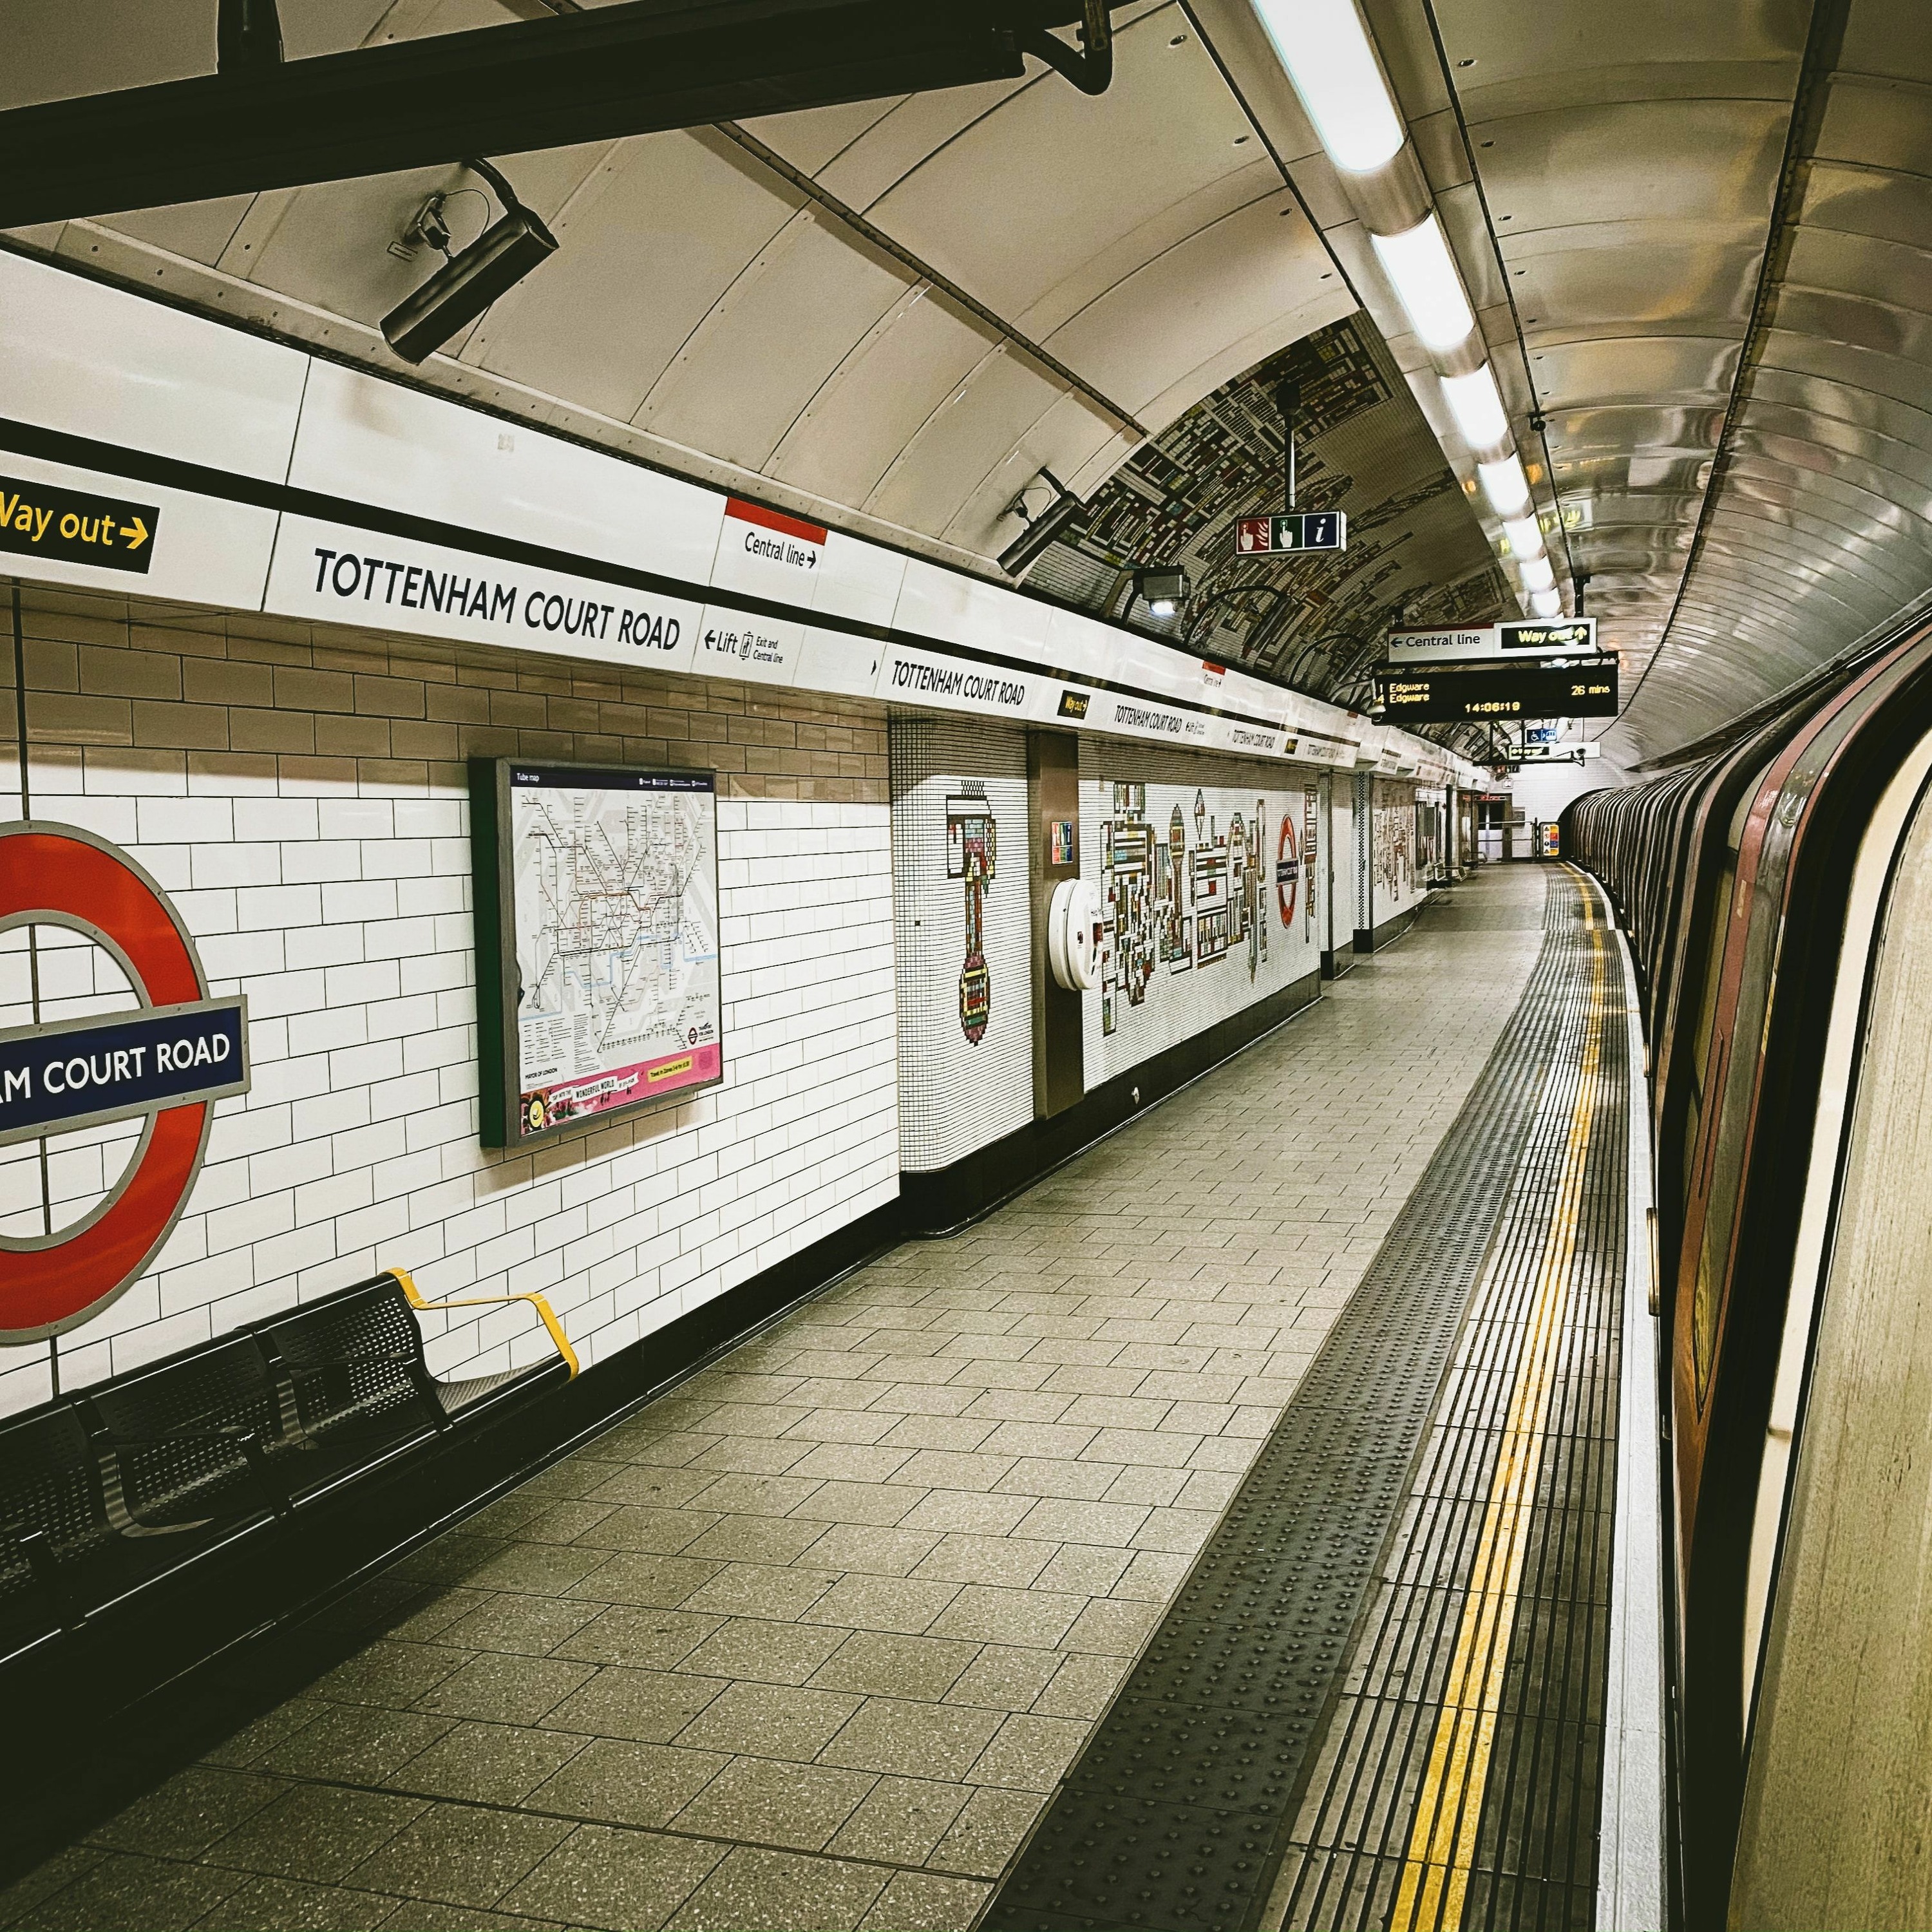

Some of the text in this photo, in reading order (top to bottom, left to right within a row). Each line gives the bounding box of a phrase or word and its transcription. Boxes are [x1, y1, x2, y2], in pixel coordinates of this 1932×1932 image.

[60, 513, 116, 545] out
[745, 531, 805, 567] Central line
[314, 547, 680, 650] TOTTENHAM COURT ROAD
[716, 631, 739, 654] Lift
[1405, 634, 1481, 647] Central line
[1518, 630, 1547, 644] Way
[753, 649, 773, 662] Central
[891, 660, 1025, 706] TOTTENHAM COURT ROAD
[1379, 683, 1430, 694] 1 Edgware
[1378, 684, 1611, 704] 4 Edgware 26 mins
[1065, 696, 1076, 713] Way
[1114, 705, 1151, 728] TOTTENHAM
[1149, 712, 1169, 731] COURT
[1166, 715, 1182, 734] ROAD
[517, 773, 529, 781] Tube
[43, 1046, 146, 1094] COURT
[156, 1033, 231, 1074] ROAD
[576, 1079, 614, 1099] WONDERFUL WORLD
